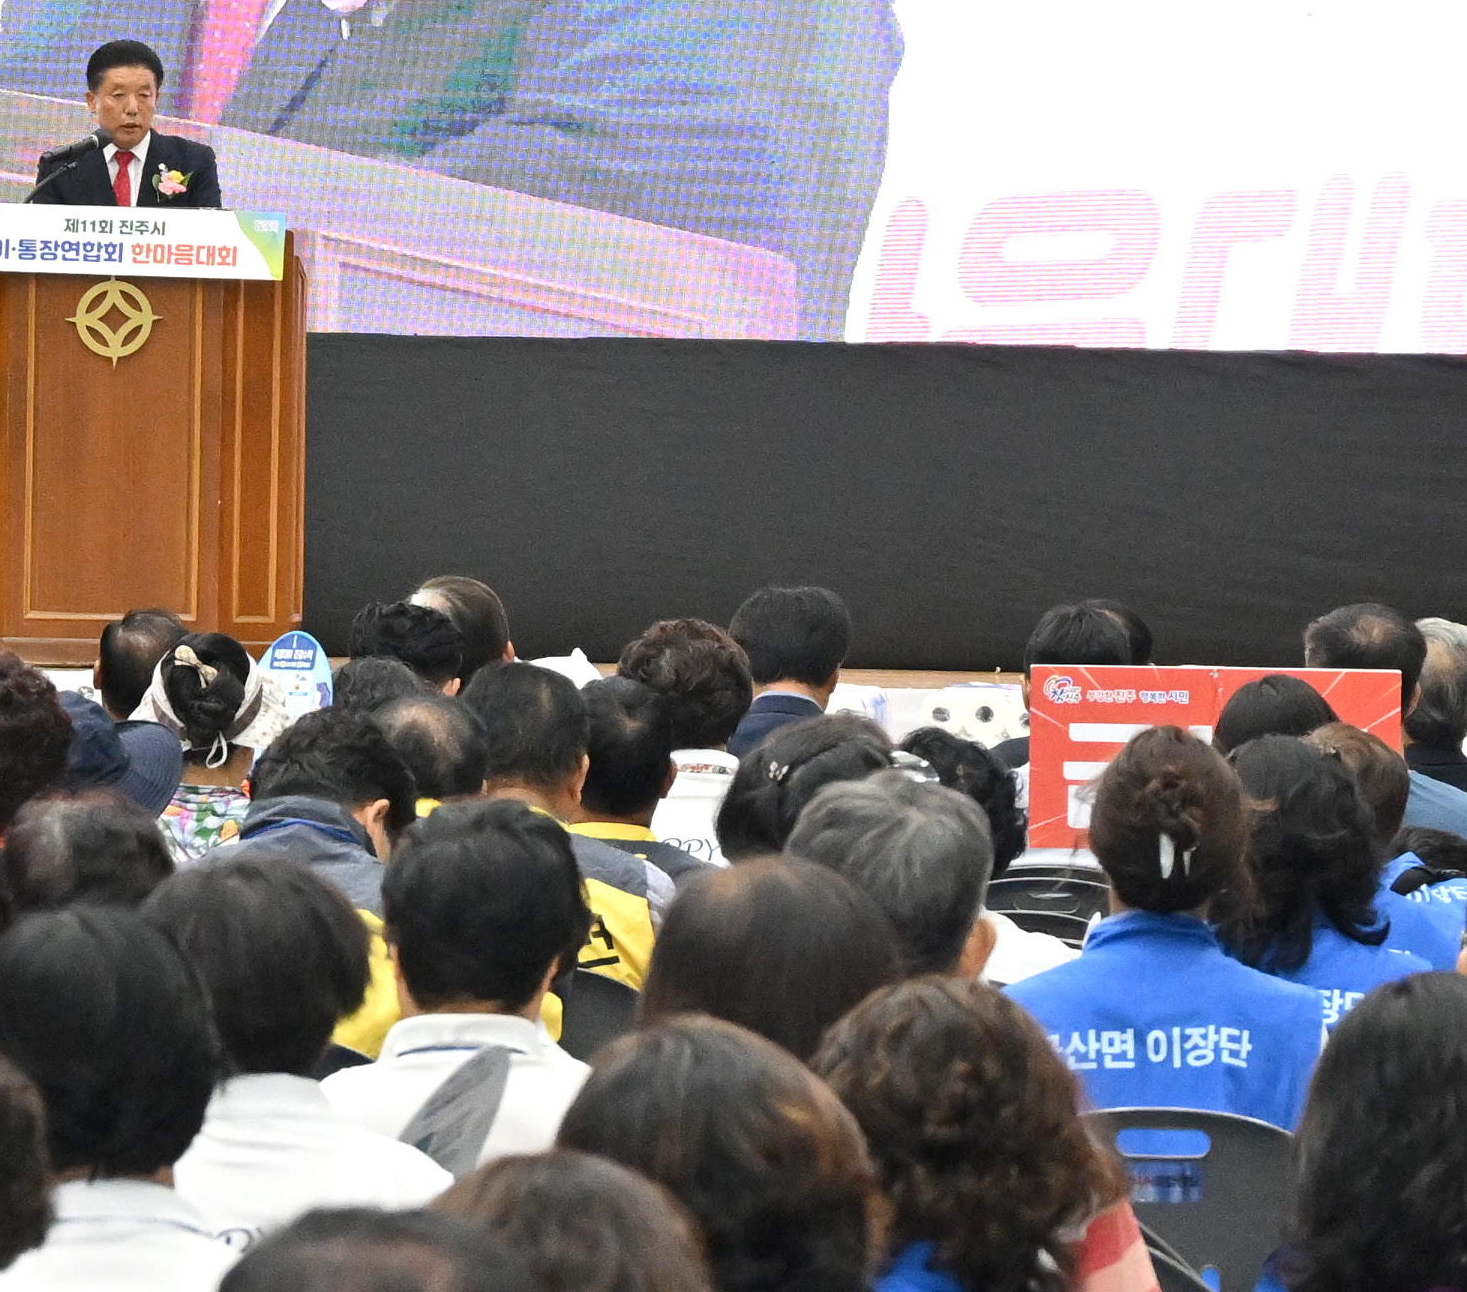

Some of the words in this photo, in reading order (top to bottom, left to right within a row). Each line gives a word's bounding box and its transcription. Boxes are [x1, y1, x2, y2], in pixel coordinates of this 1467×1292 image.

[64, 218, 113, 235] 제11회
[118, 219, 166, 237] 진주시
[131, 242, 238, 267] 한마음대회
[1168, 690, 1190, 704] 시민
[1146, 1024, 1253, 1069] 이장단
